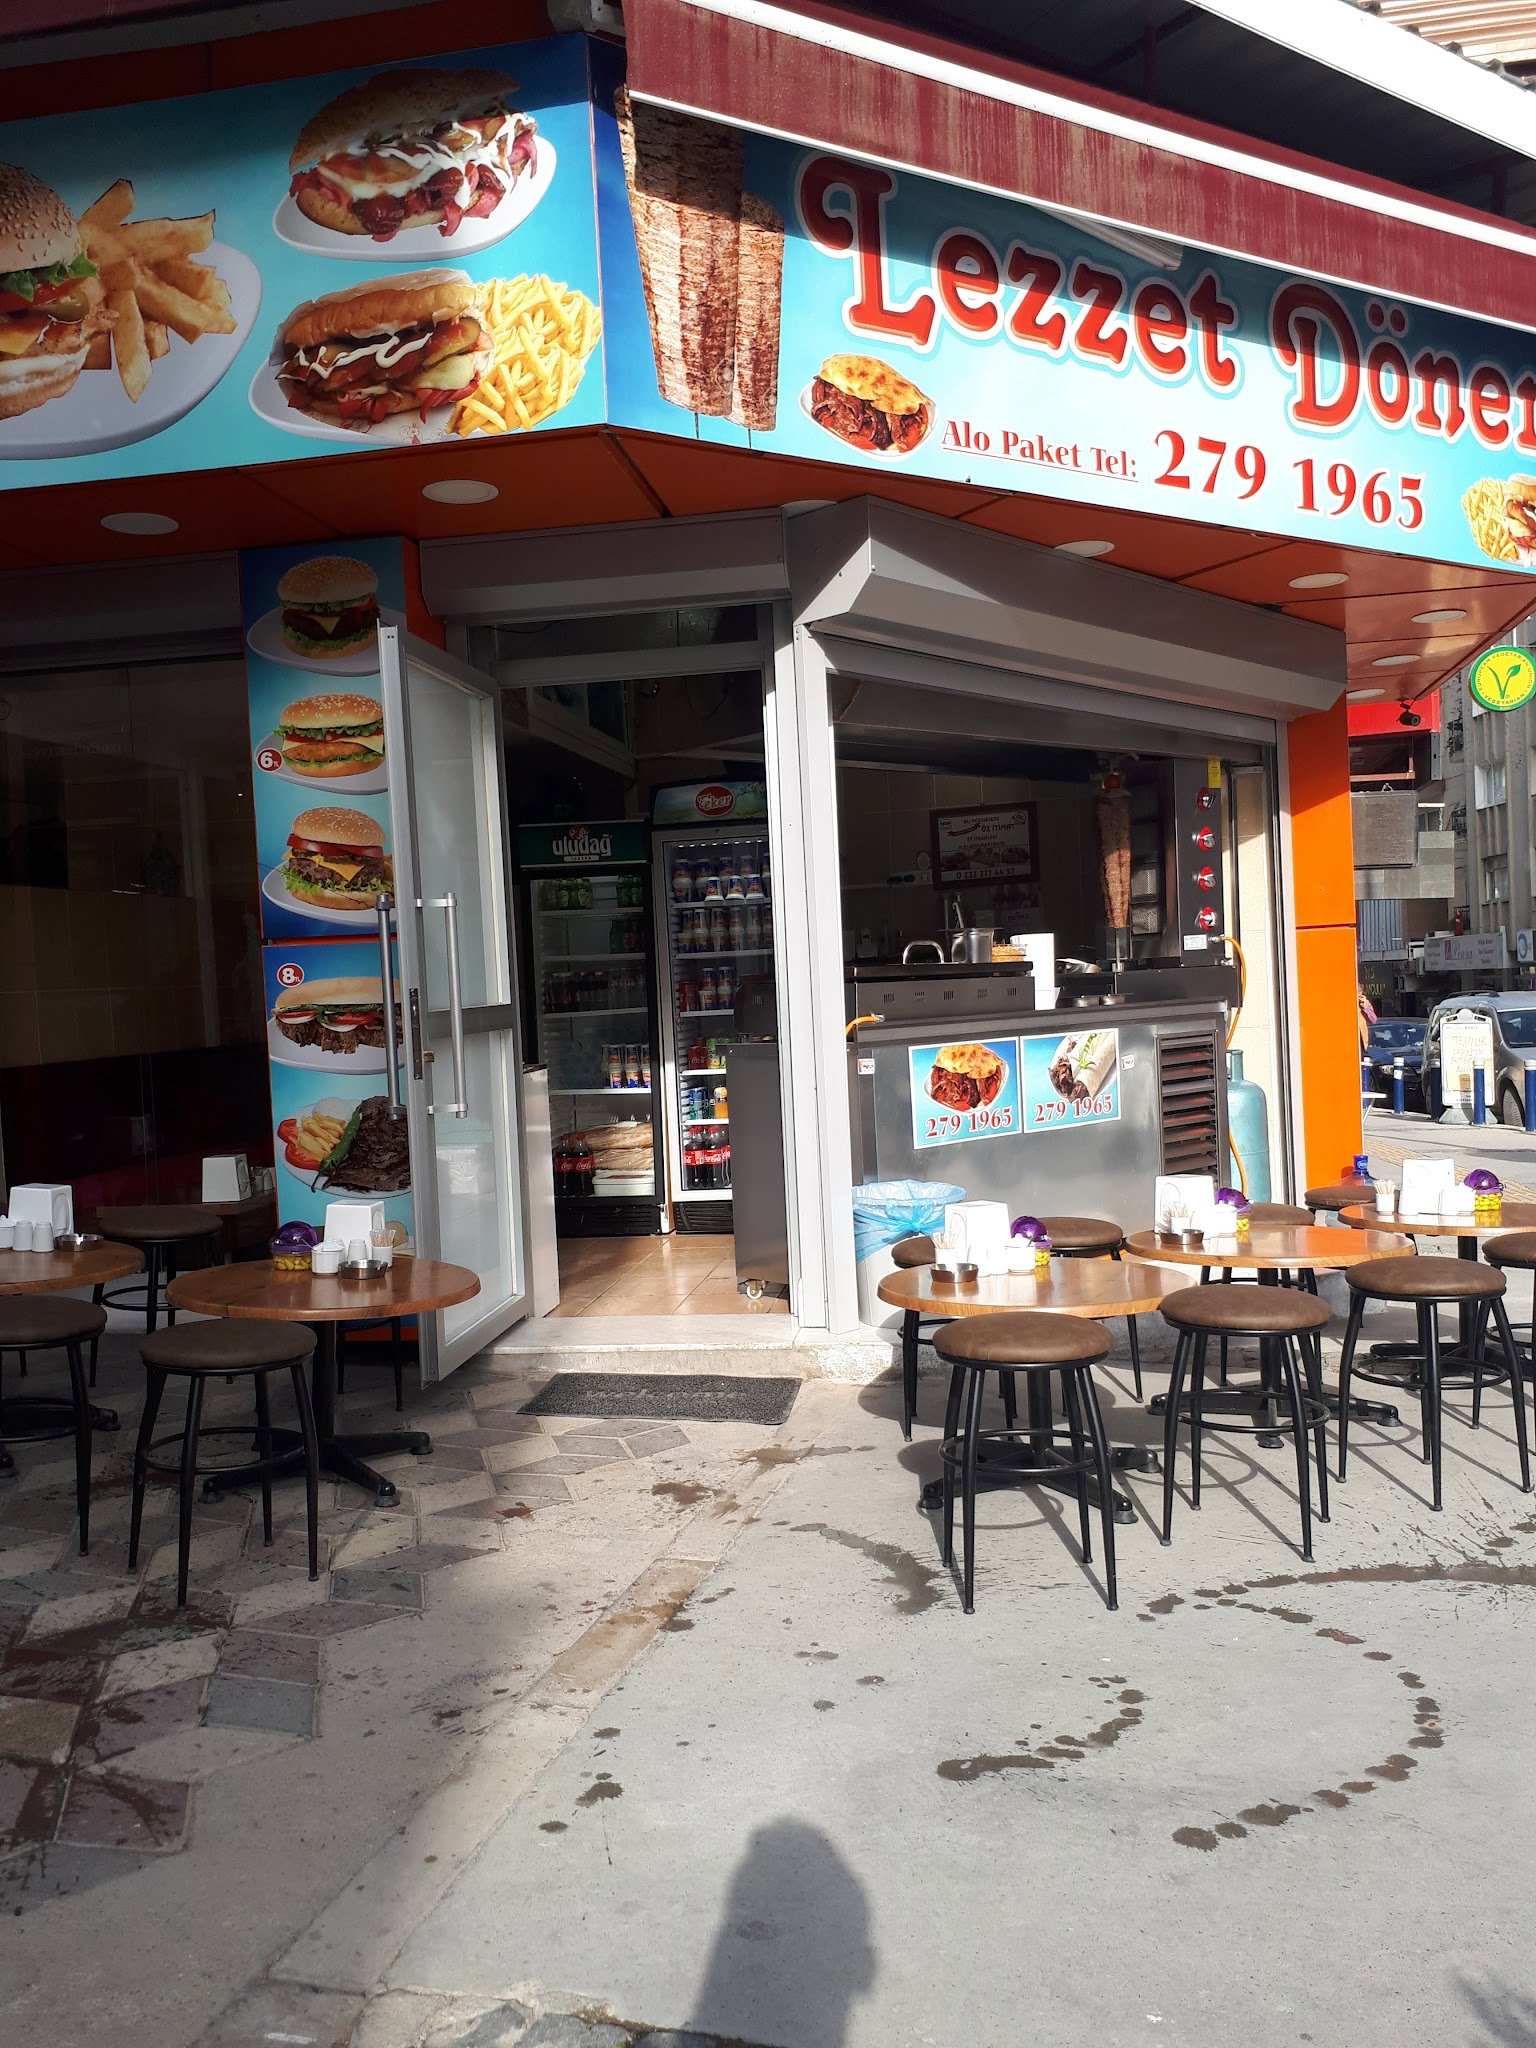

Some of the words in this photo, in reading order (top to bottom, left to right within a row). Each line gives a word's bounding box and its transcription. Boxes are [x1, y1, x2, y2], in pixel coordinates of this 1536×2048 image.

[799, 157, 1237, 387] Lezzet
[941, 420, 991, 451] Alo
[1002, 430, 1081, 469] Paket
[1090, 445, 1137, 478] Tel:
[1153, 430, 1267, 500] 279
[1293, 458, 1424, 530] 1965
[1484, 693, 1526, 705] VEGETARIAN
[552, 832, 612, 857] uludağ
[926, 1115, 961, 1138] 279
[968, 1107, 1013, 1131] 1965
[1033, 1101, 1067, 1123] 279
[1071, 1095, 1112, 1118] 1965
